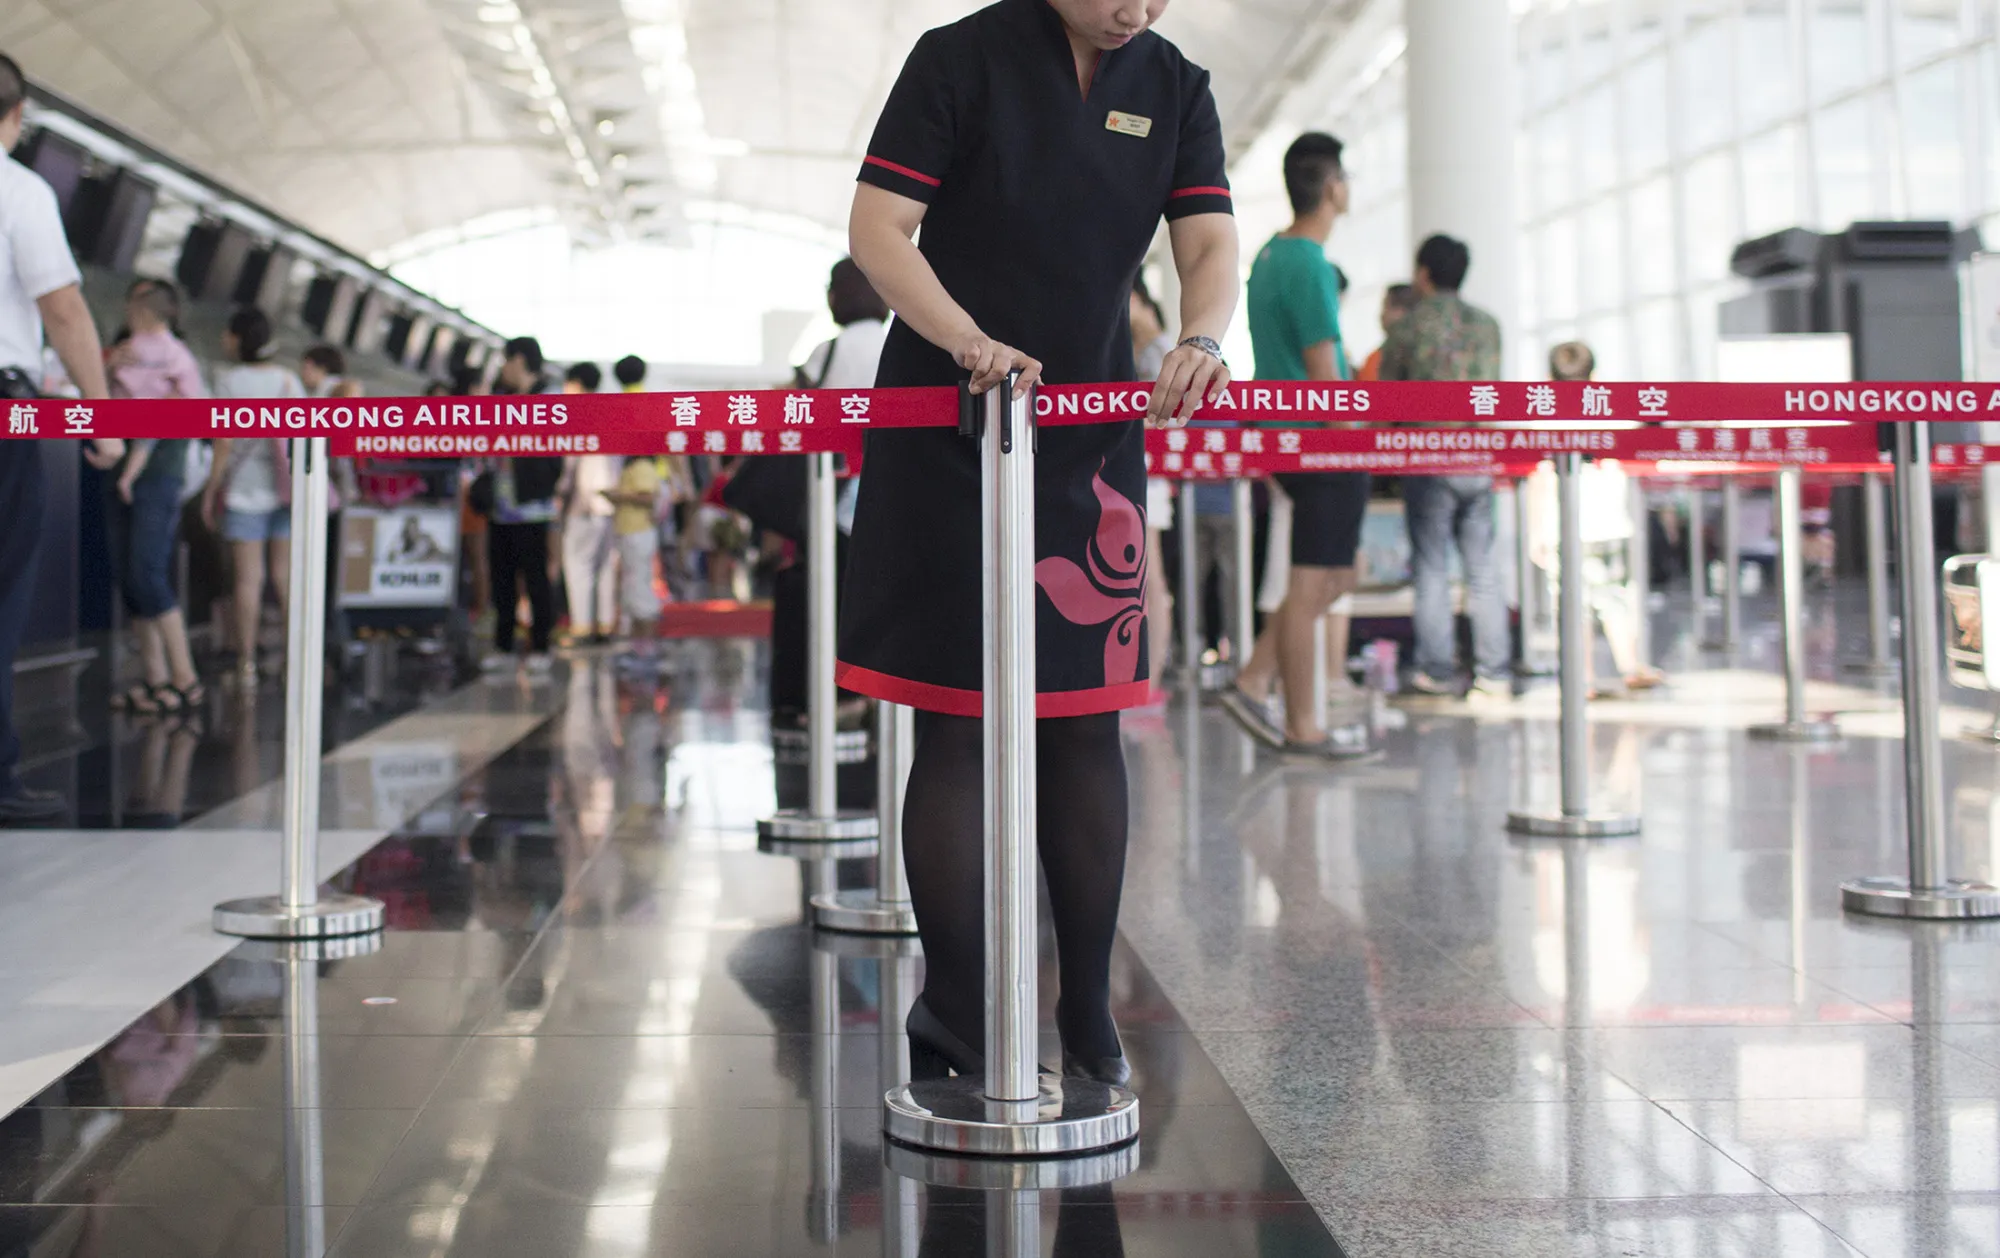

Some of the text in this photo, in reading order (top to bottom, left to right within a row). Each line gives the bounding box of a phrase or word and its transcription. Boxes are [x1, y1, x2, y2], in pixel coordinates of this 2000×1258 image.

[670, 393, 871, 426] 香港航空
[1213, 387, 1371, 412] AIRLINES
[1469, 385, 1669, 417] 香港航空
[1785, 389, 1978, 412] HONGKONG
[211, 403, 568, 429] HONGKONG AIRLINES
[356, 434, 600, 453] HONGKONG AIRLINES
[1375, 430, 1615, 450] HONGKONG AIRLINES
